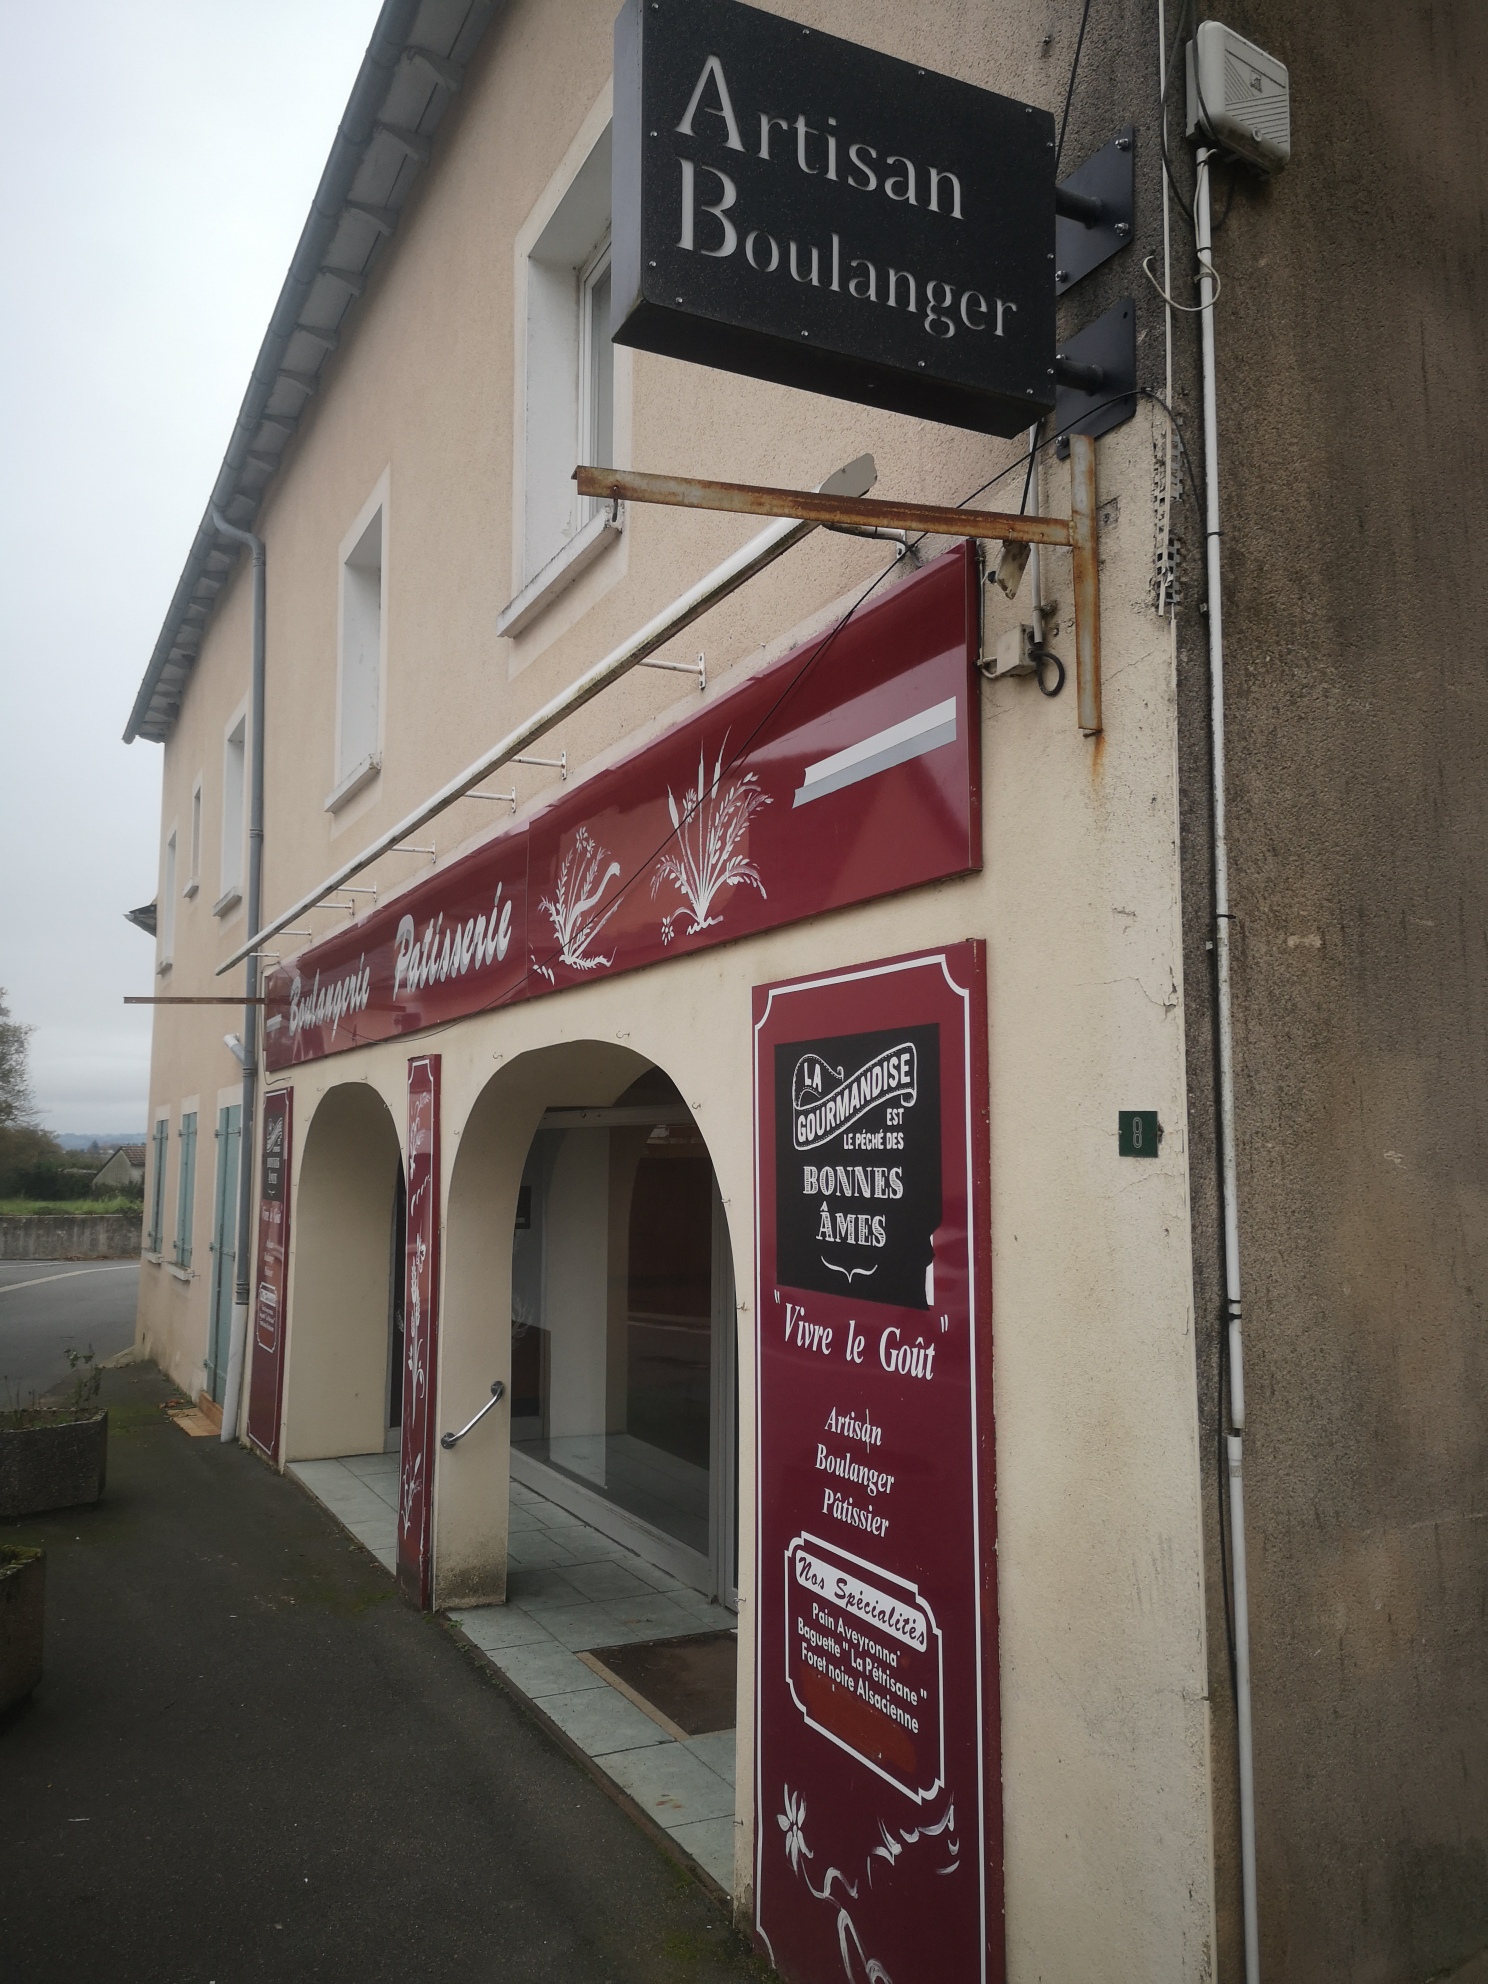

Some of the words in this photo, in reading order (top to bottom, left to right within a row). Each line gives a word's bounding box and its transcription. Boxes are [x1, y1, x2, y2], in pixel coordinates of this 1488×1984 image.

[675, 54, 964, 219] Artisan
[675, 155, 1017, 338] Boulanger
[393, 881, 512, 1001] Patisserie
[798, 1053, 911, 1143] GOURMANDISE
[804, 1062, 821, 1092] LA
[843, 1134, 853, 1150] LE
[856, 1129, 884, 1150] PÉCHÉ
[886, 1132, 904, 1150] DES
[887, 1108, 904, 1125] EST
[1133, 1116, 1143, 1149] 8
[803, 1166, 904, 1199] BONNES
[816, 1201, 886, 1247] ÂMES
[846, 1320, 865, 1363] le
[825, 1407, 882, 1446] Artisan
[815, 1443, 895, 1496] Boulanger
[822, 1488, 889, 1537] Pâtissier
[798, 1557, 825, 1590] Nos
[834, 1578, 926, 1645] Spécialités
[813, 1603, 834, 1631] Pain
[837, 1617, 900, 1667] Aveyronna
[798, 1617, 840, 1657] Baguette
[866, 1657, 918, 1705] Pétrisane
[802, 1641, 827, 1673] Foret
[829, 1665, 854, 1692] noire
[857, 1678, 919, 1734] Alsacienne
